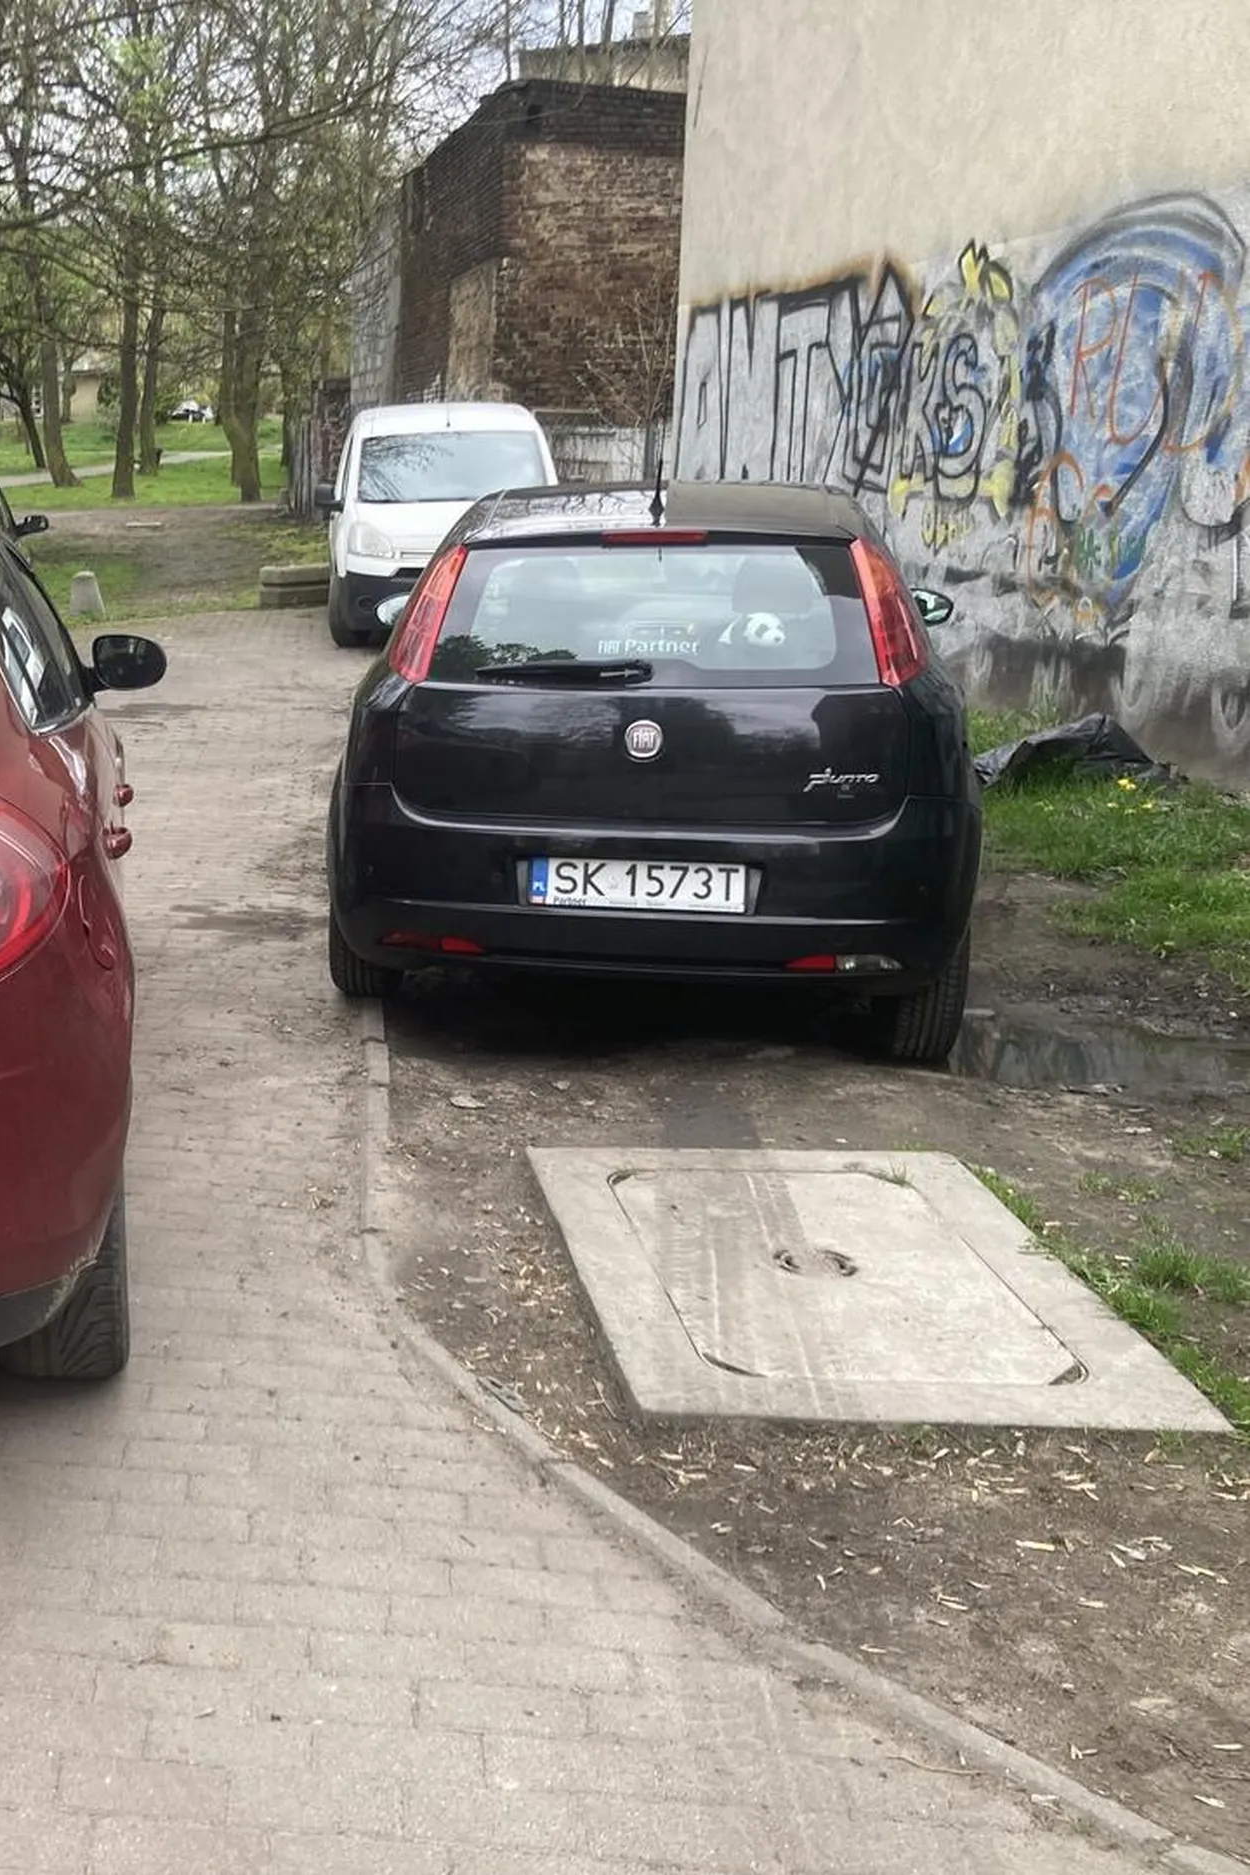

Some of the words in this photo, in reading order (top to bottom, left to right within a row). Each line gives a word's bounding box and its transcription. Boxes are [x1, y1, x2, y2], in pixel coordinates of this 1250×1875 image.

[623, 638, 699, 655] Partner
[553, 861, 607, 897] SK
[625, 863, 741, 902] 1573T
